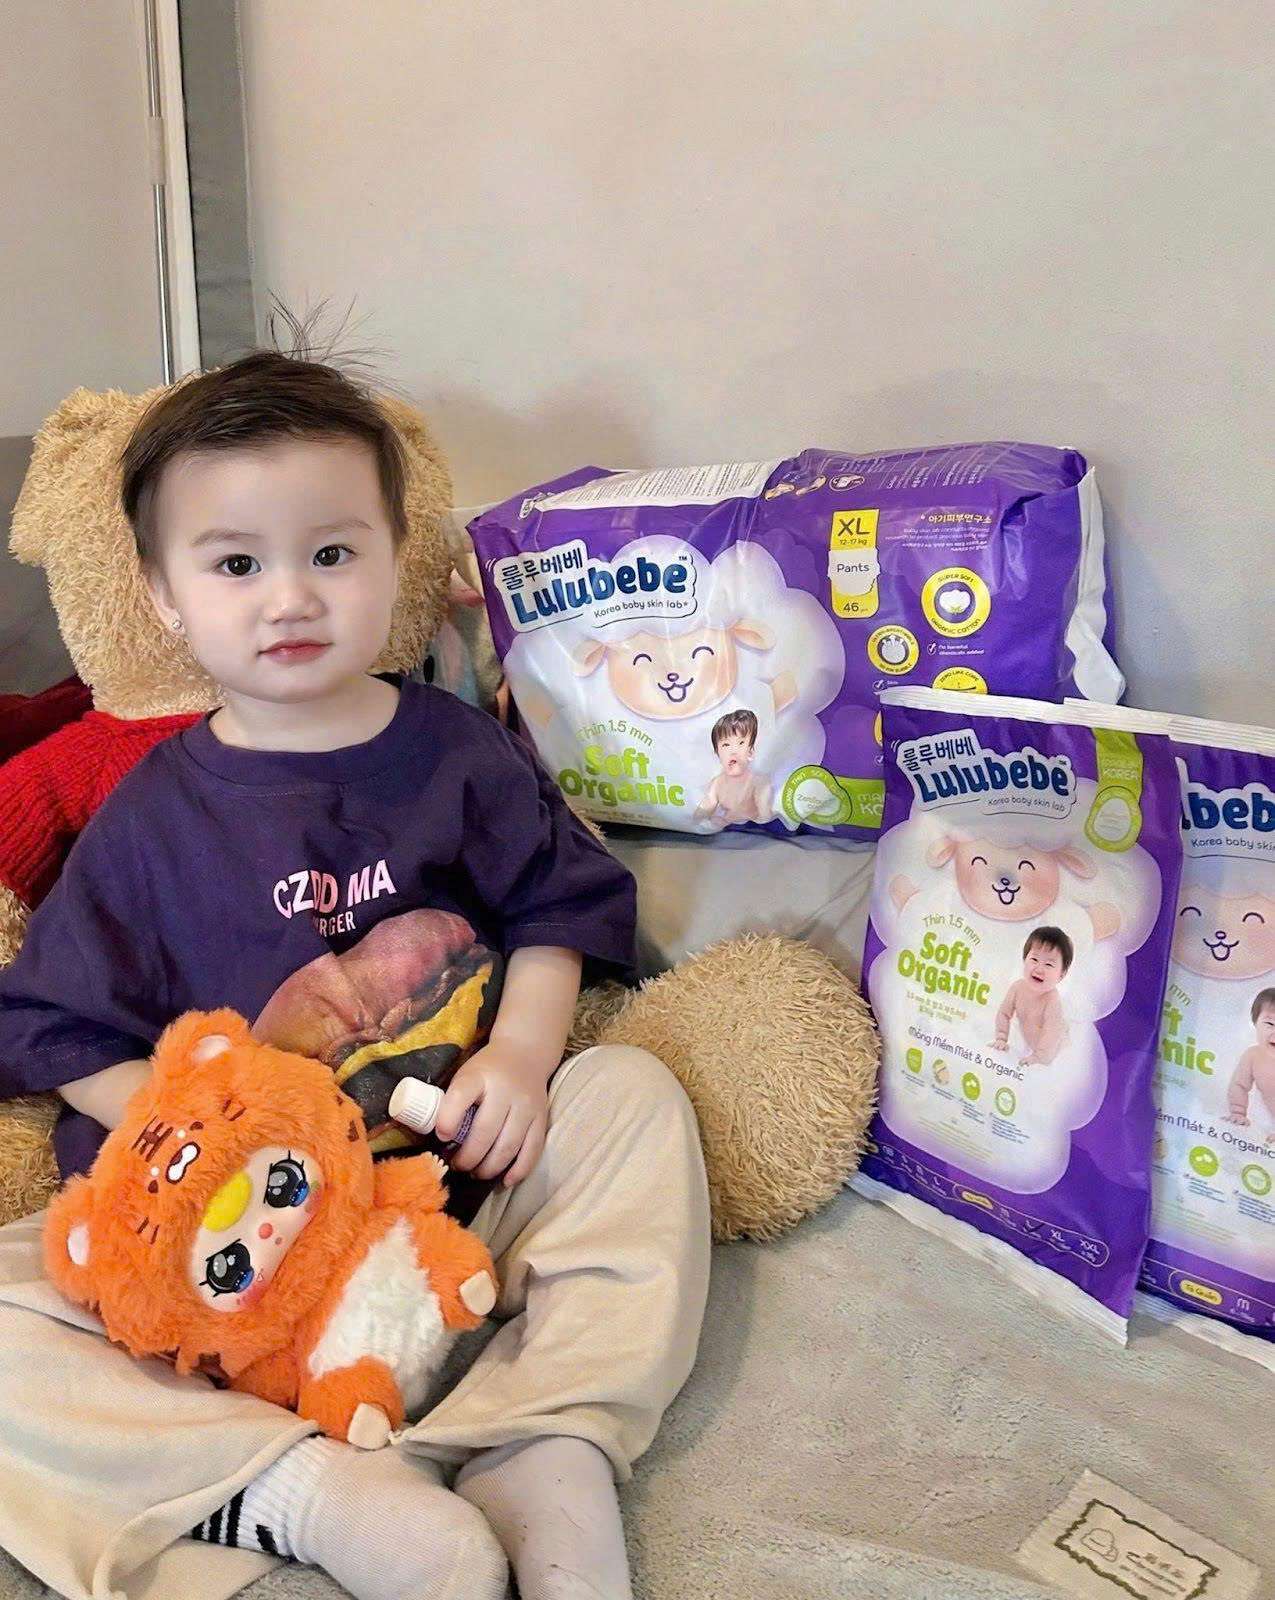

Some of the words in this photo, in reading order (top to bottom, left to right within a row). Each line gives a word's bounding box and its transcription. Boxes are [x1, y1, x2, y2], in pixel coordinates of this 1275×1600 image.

[838, 517, 870, 536] XL
[837, 563, 870, 573] Pants
[511, 556, 688, 624] Lulubebe
[594, 605, 621, 618] Korea
[622, 600, 645, 610] baby
[647, 600, 664, 608] skin
[843, 602, 860, 613] 46
[576, 720, 606, 741] Thin
[608, 718, 626, 733] 1.5
[629, 727, 653, 746] mm
[584, 743, 650, 779] Soft
[558, 767, 686, 808] Organic
[913, 755, 1070, 803] Lulubebe
[988, 797, 1009, 806] Korea
[1012, 797, 1032, 806] baby
[1033, 800, 1050, 808] skin
[1052, 801, 1065, 812] lab
[1191, 838, 1222, 848] Korea
[1226, 837, 1254, 850] baby
[347, 859, 397, 908] MA
[922, 913, 945, 928] Thin
[949, 914, 963, 929] 1.5
[963, 924, 982, 946] mm
[920, 931, 972, 971] Soft
[898, 949, 991, 1006] Organic
[974, 1053, 983, 1064] &
[984, 1057, 1025, 1081] Organic
[1207, 1126, 1218, 1139] &
